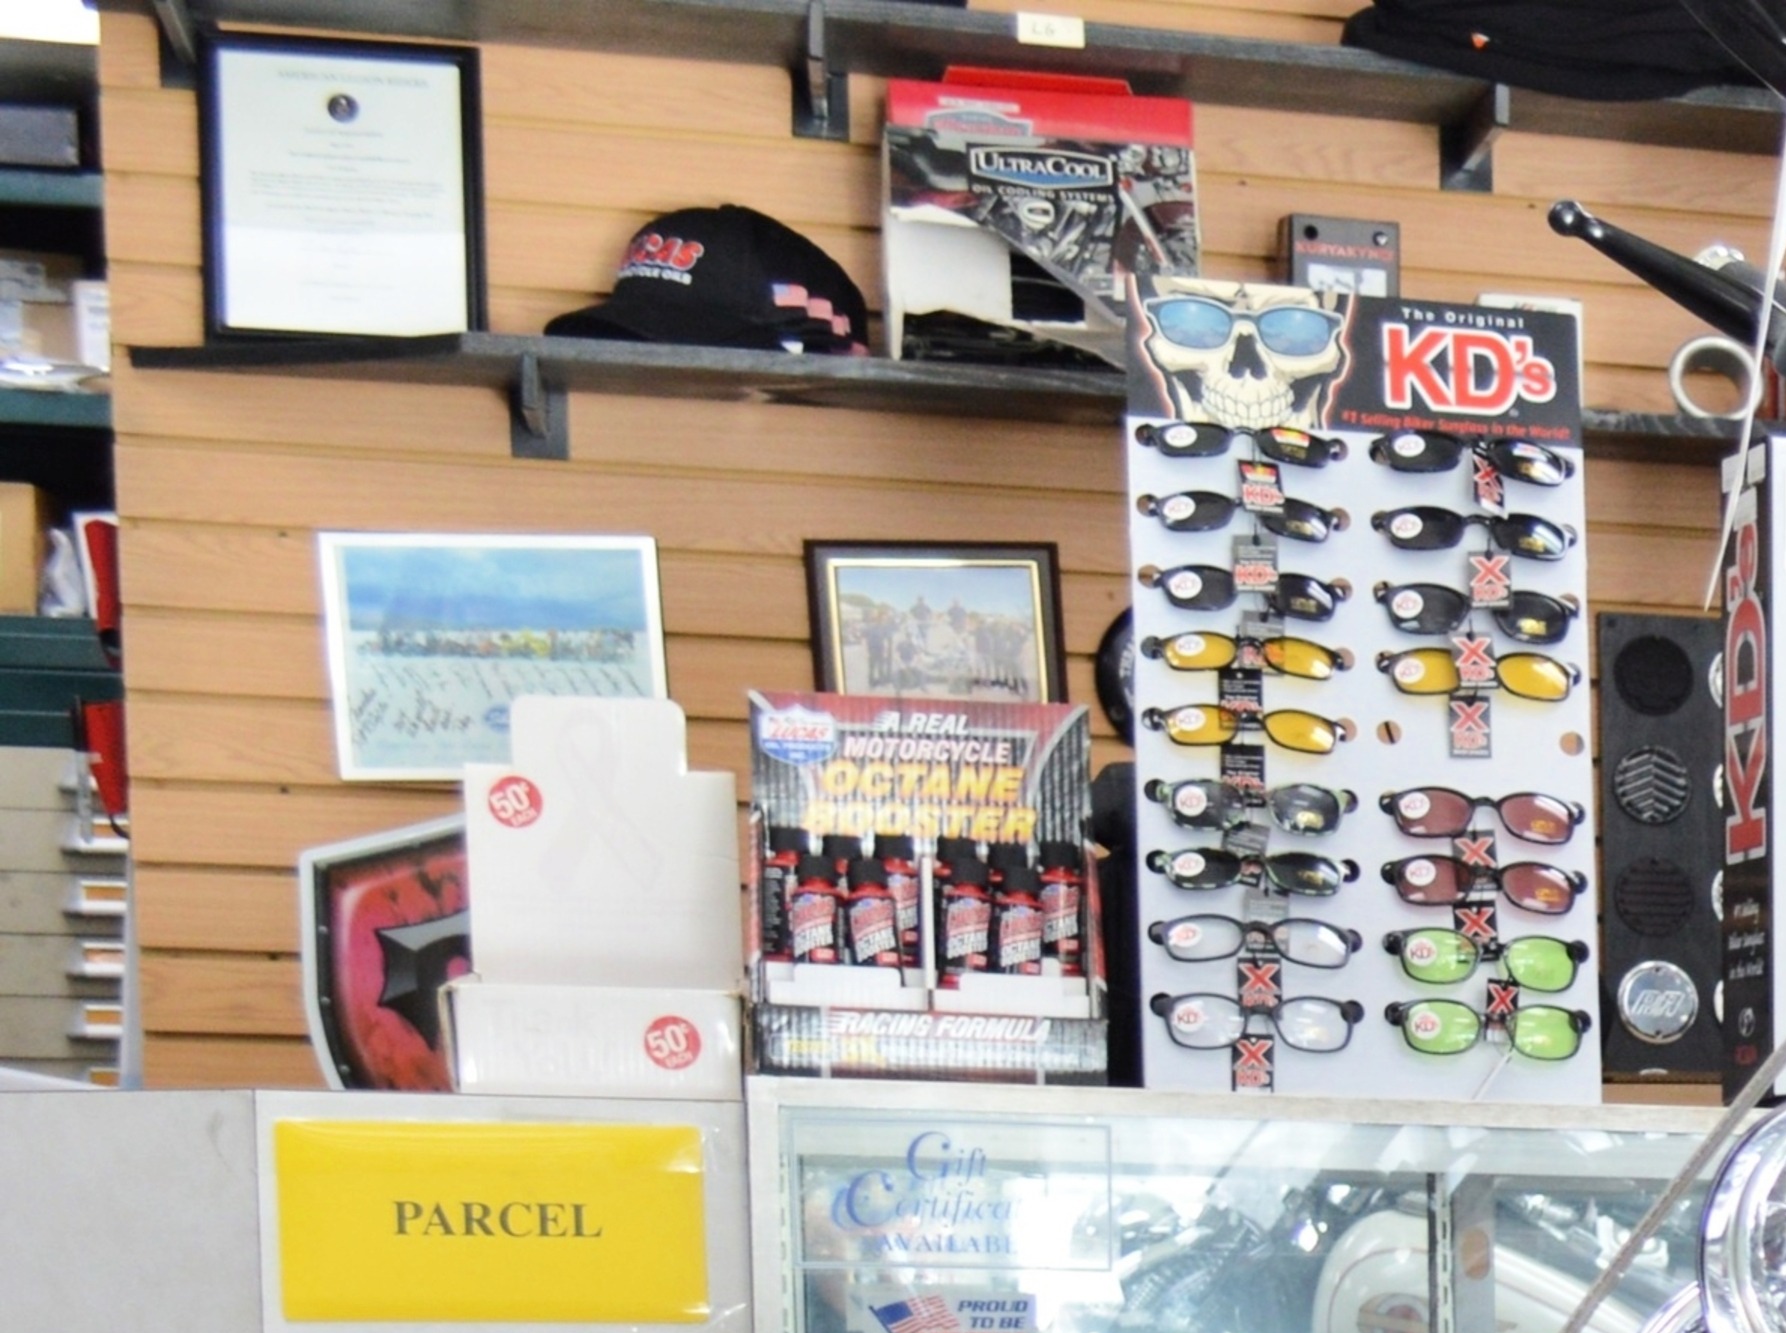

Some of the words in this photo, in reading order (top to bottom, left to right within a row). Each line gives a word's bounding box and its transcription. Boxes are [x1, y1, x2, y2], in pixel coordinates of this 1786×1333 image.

[972, 183, 993, 195] OIL
[998, 184, 1056, 201] COOLING
[1059, 190, 1116, 204] SYSTEMS
[1402, 306, 1434, 322] The
[1444, 311, 1525, 328] Original
[1383, 323, 1557, 416] KD's
[1360, 411, 1399, 430] Selling
[1403, 414, 1434, 430] Biker
[881, 711, 901, 732] A
[908, 712, 969, 736] REAL
[842, 736, 1011, 764] MOTORCYCLE
[820, 758, 1026, 801] OCTANE
[802, 800, 1037, 843] BOOSTER
[842, 1011, 932, 1037] RACING
[935, 1015, 1051, 1042] FORMULA
[905, 1130, 987, 1182] Gift
[392, 1199, 604, 1239] PARCEL
[957, 1300, 1028, 1313] PROUD
[970, 1316, 996, 1329] TO
[999, 1316, 1024, 1329] BE
